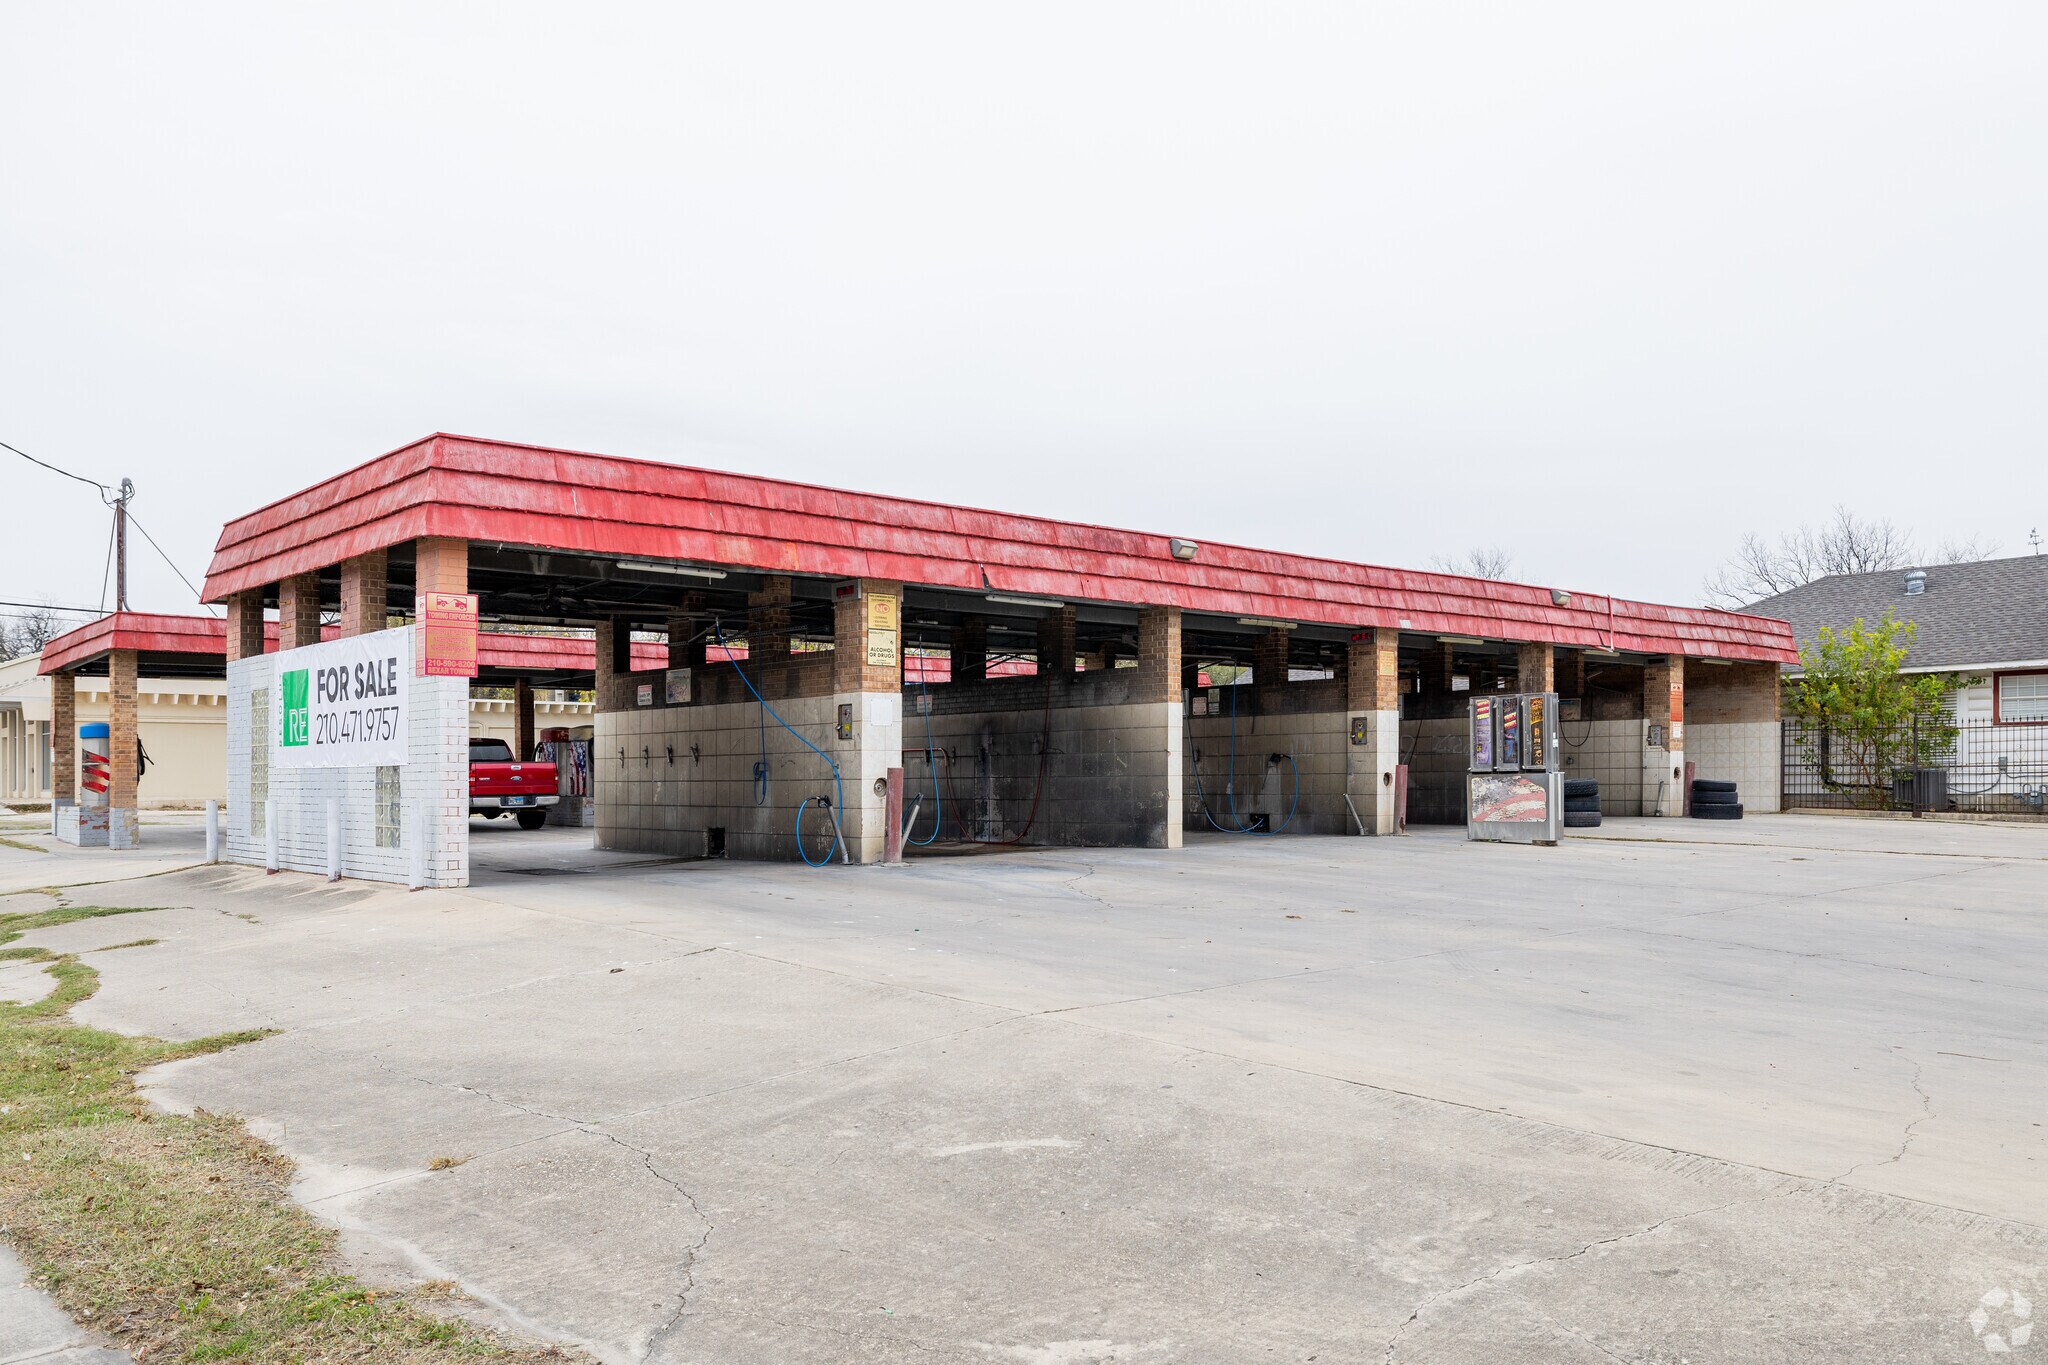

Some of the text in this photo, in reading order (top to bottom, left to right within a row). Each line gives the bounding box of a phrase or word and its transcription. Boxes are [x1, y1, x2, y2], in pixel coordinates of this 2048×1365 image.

[428, 612, 476, 621] TOWING ENFORCED
[317, 657, 397, 704] FOR SALE
[289, 707, 308, 743] RE
[316, 706, 399, 744] 210.471.9757
